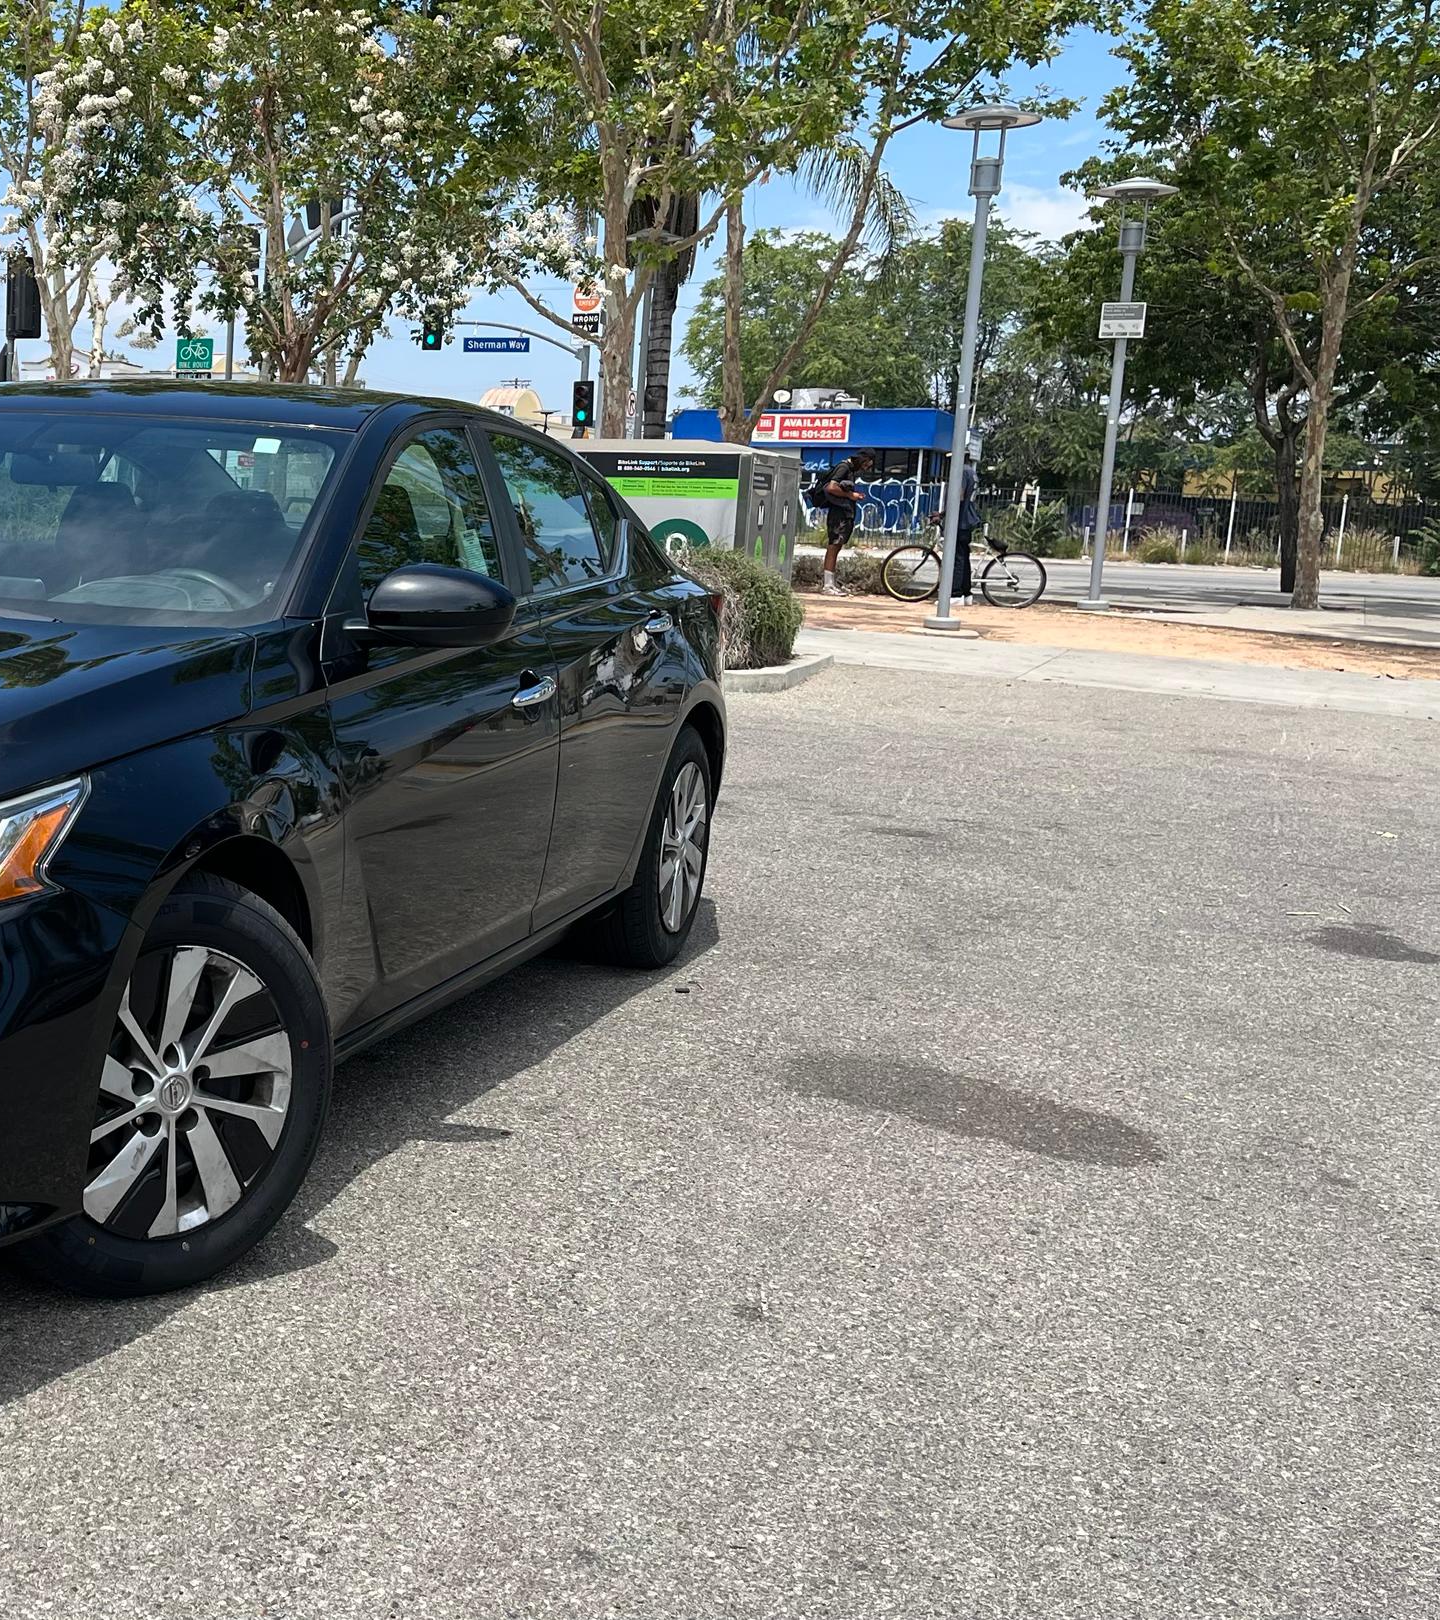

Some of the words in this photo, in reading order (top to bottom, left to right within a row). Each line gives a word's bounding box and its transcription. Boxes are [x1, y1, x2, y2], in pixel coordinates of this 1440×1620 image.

[467, 340, 507, 350] Sherman
[508, 340, 527, 352] Way
[178, 361, 190, 369] BIKE
[192, 361, 210, 369] ROUTE
[783, 418, 843, 427] AVAILABLE
[801, 429, 842, 439] 501-2212
